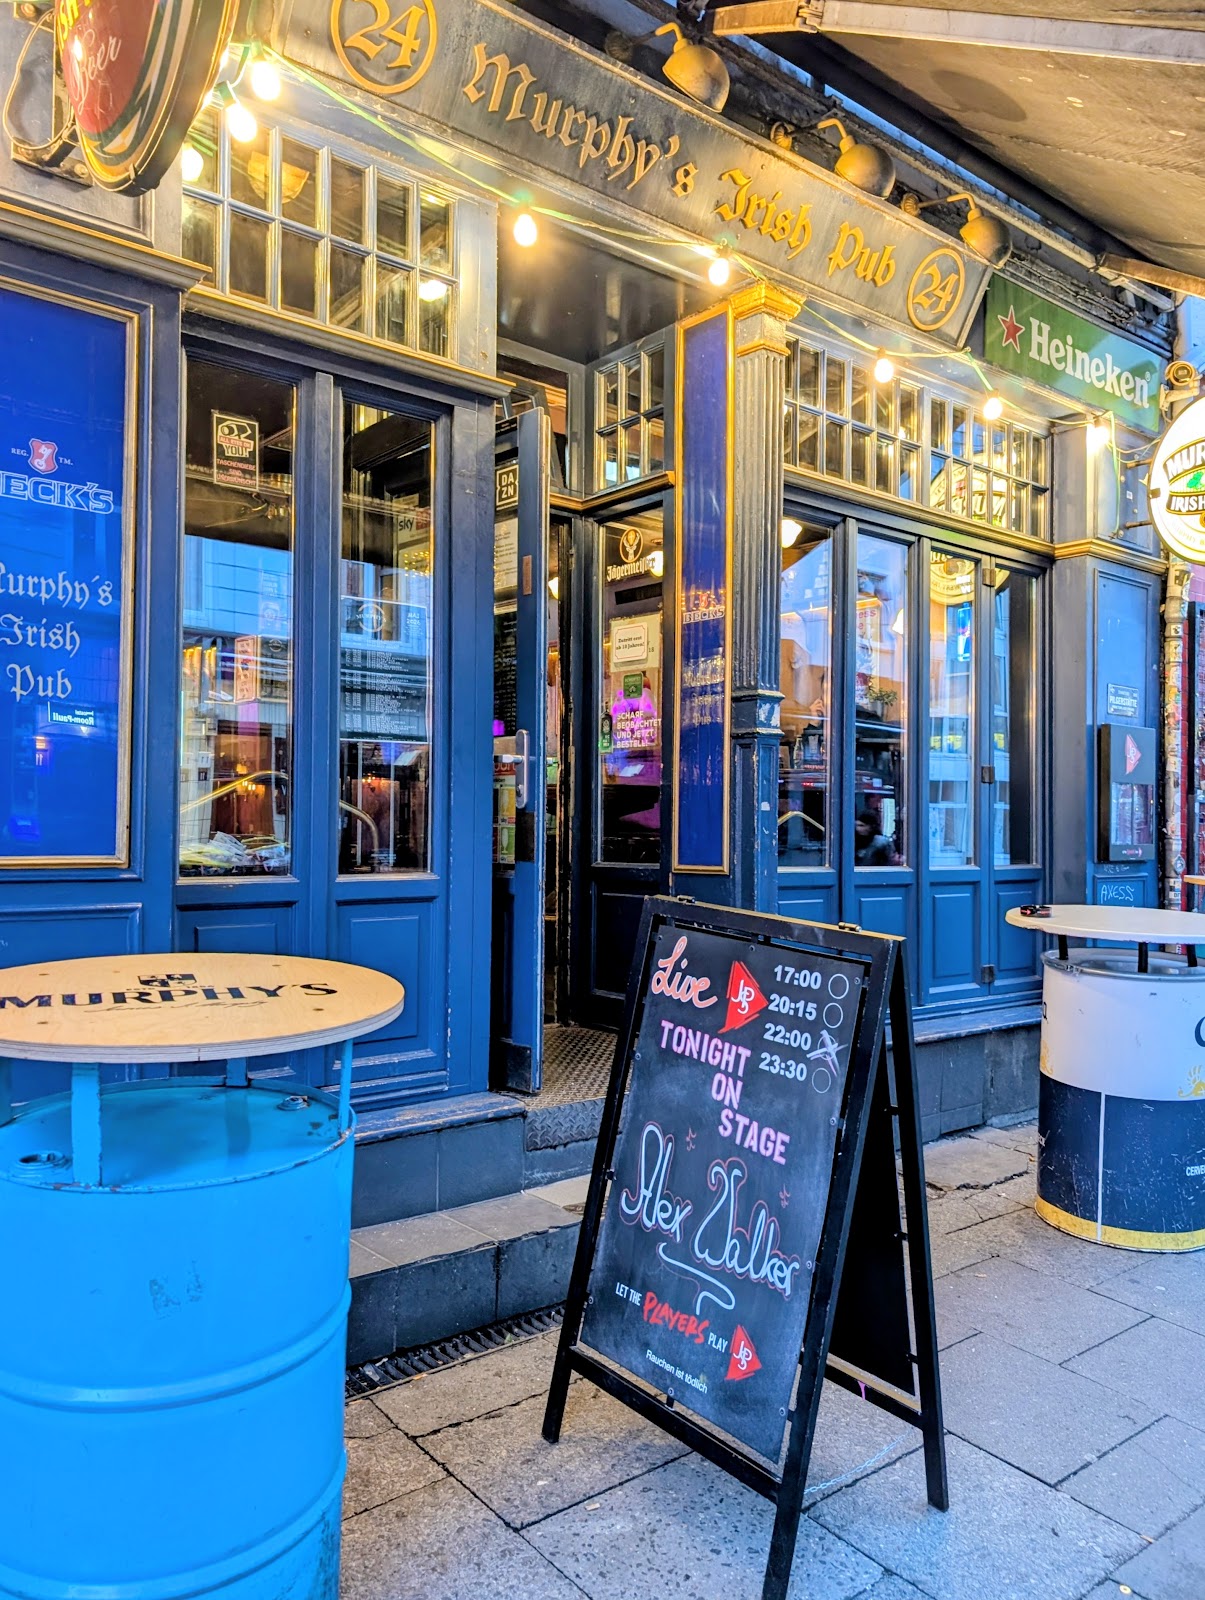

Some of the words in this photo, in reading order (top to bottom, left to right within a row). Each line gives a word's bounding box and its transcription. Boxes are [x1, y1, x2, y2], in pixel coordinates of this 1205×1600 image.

[344, 0, 425, 68] 24
[463, 43, 699, 198] Murphy's
[714, 168, 813, 260] Irish
[828, 221, 896, 288] Pub
[913, 263, 958, 314] 24
[11, 447, 29, 457] REG.
[58, 456, 73, 466] TM.
[225, 445, 248, 457] YOU!
[0, 613, 81, 658] Irish
[7, 663, 72, 702] Pub
[617, 710, 644, 721] SCHARF
[617, 718, 662, 731] BEOBACHTET
[617, 730, 631, 739] UND
[633, 729, 653, 739] JETZT
[652, 936, 718, 1008] Live
[774, 965, 822, 990] 17:00
[0, 983, 338, 1010] MURPHY'S
[768, 993, 817, 1021] 20:15
[660, 1020, 752, 1078] TONIGHT
[763, 1022, 812, 1051] 22:00
[758, 1052, 808, 1082] 23:30
[711, 1073, 743, 1110] ON
[718, 1108, 791, 1165] STAGE
[620, 1122, 693, 1243] Alex
[692, 1163, 800, 1298] Walker
[615, 1282, 628, 1299] LET
[629, 1289, 642, 1306] THE
[643, 1291, 710, 1344] PLAYERS
[708, 1332, 728, 1353] PLAY
[645, 1349, 675, 1375] Rauchen
[675, 1367, 684, 1379] ist
[685, 1374, 708, 1394] tödlich
